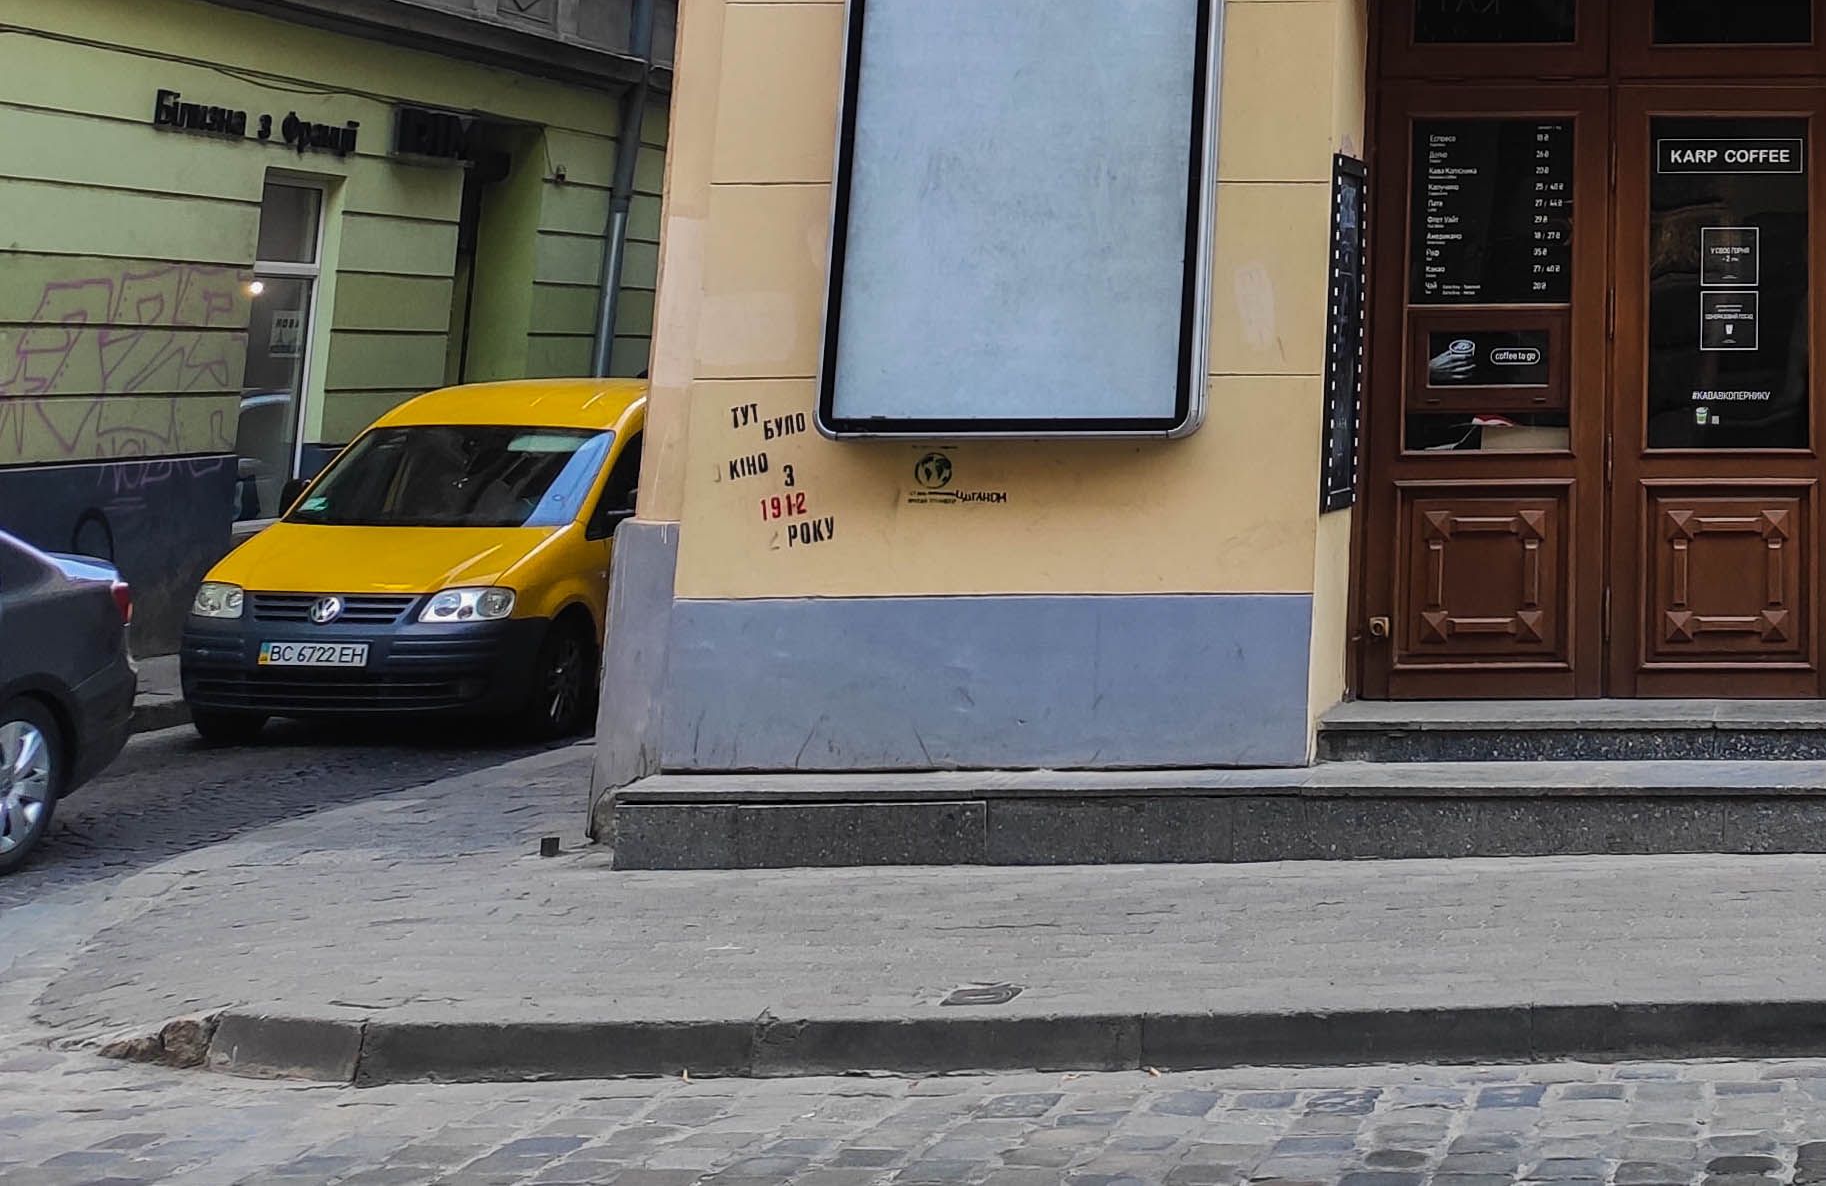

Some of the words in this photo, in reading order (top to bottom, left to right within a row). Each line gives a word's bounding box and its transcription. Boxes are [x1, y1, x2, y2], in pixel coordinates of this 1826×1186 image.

[155, 88, 247, 137] Білизна
[258, 114, 272, 140] з
[1671, 149, 1717, 163] KARP
[1724, 149, 1790, 163] COFFEE
[1495, 352, 1517, 360] coffee
[1518, 352, 1526, 360] to
[1527, 353, 1536, 361] go
[731, 403, 759, 429] ТУТ
[763, 412, 806, 440] БУЛО
[729, 452, 768, 480] КІНО
[783, 464, 795, 487] З
[760, 492, 807, 521] 1912
[788, 516, 834, 547] РОКУ
[269, 645, 294, 663] BC
[297, 646, 336, 663] 6722
[339, 648, 365, 664] EH
